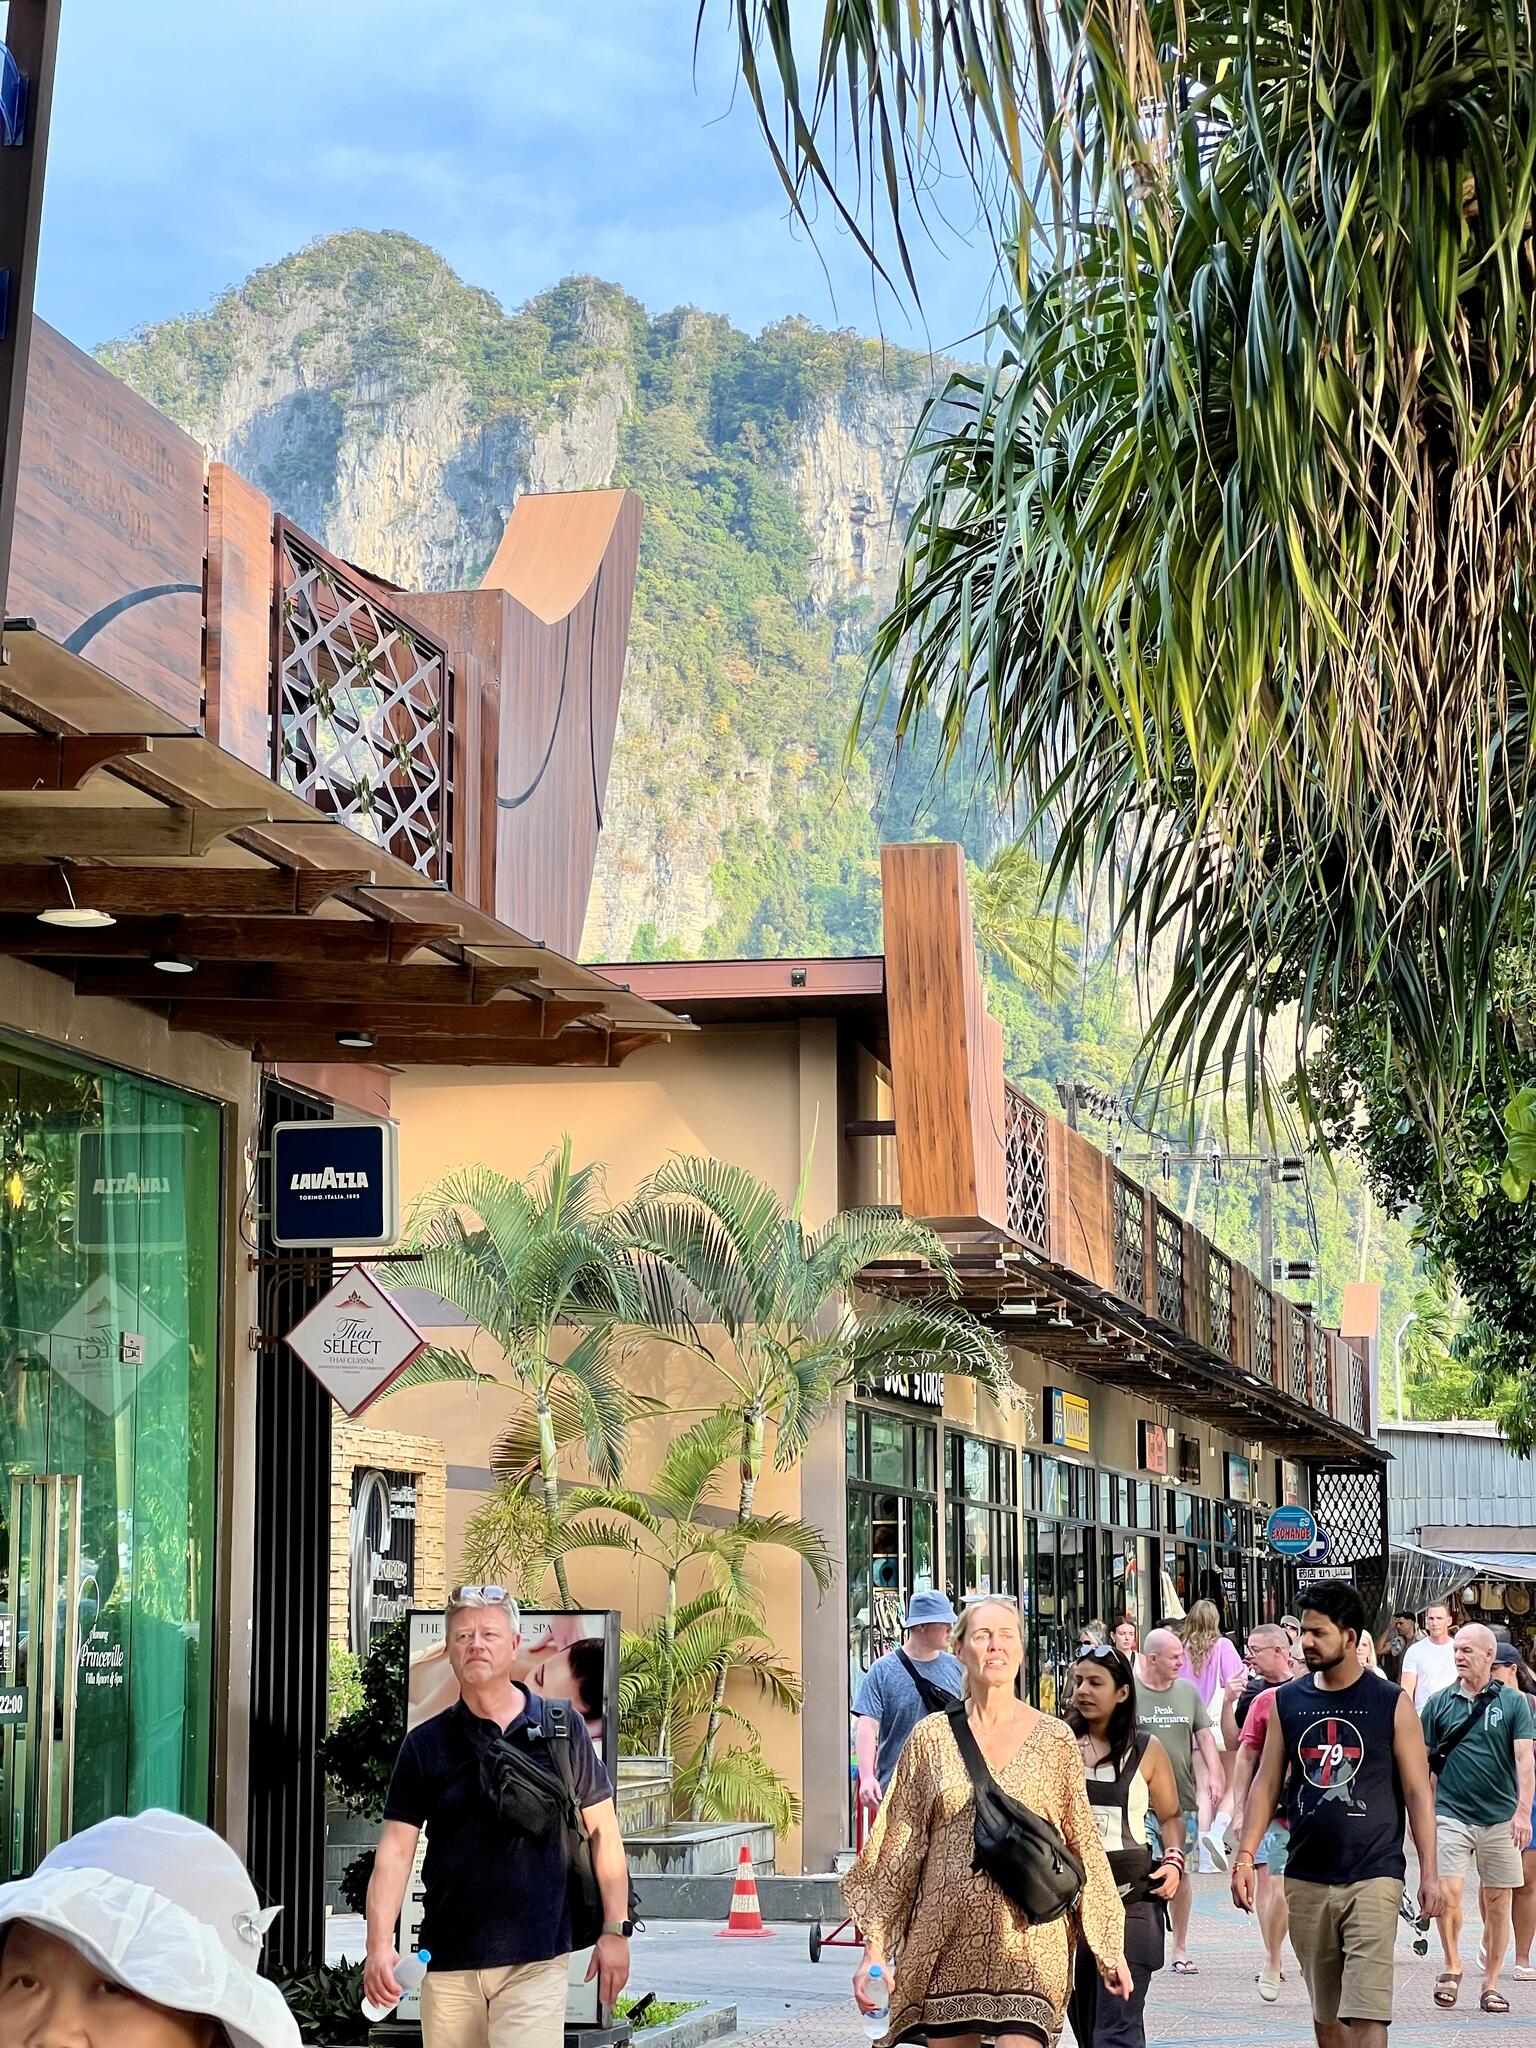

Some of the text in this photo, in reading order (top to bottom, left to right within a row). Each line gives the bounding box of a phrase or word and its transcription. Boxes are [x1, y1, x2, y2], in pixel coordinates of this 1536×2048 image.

[290, 1166, 369, 1190] LAVAZZA
[333, 1318, 373, 1340] Thai
[323, 1340, 382, 1355] SELECT
[419, 1623, 441, 1634] THE
[532, 1623, 553, 1634] SPA
[80, 1643, 124, 1667] Princeville
[1153, 1705, 1174, 1714] Peak
[1139, 1714, 1190, 1724] Performance
[1317, 1743, 1343, 1767] 79
